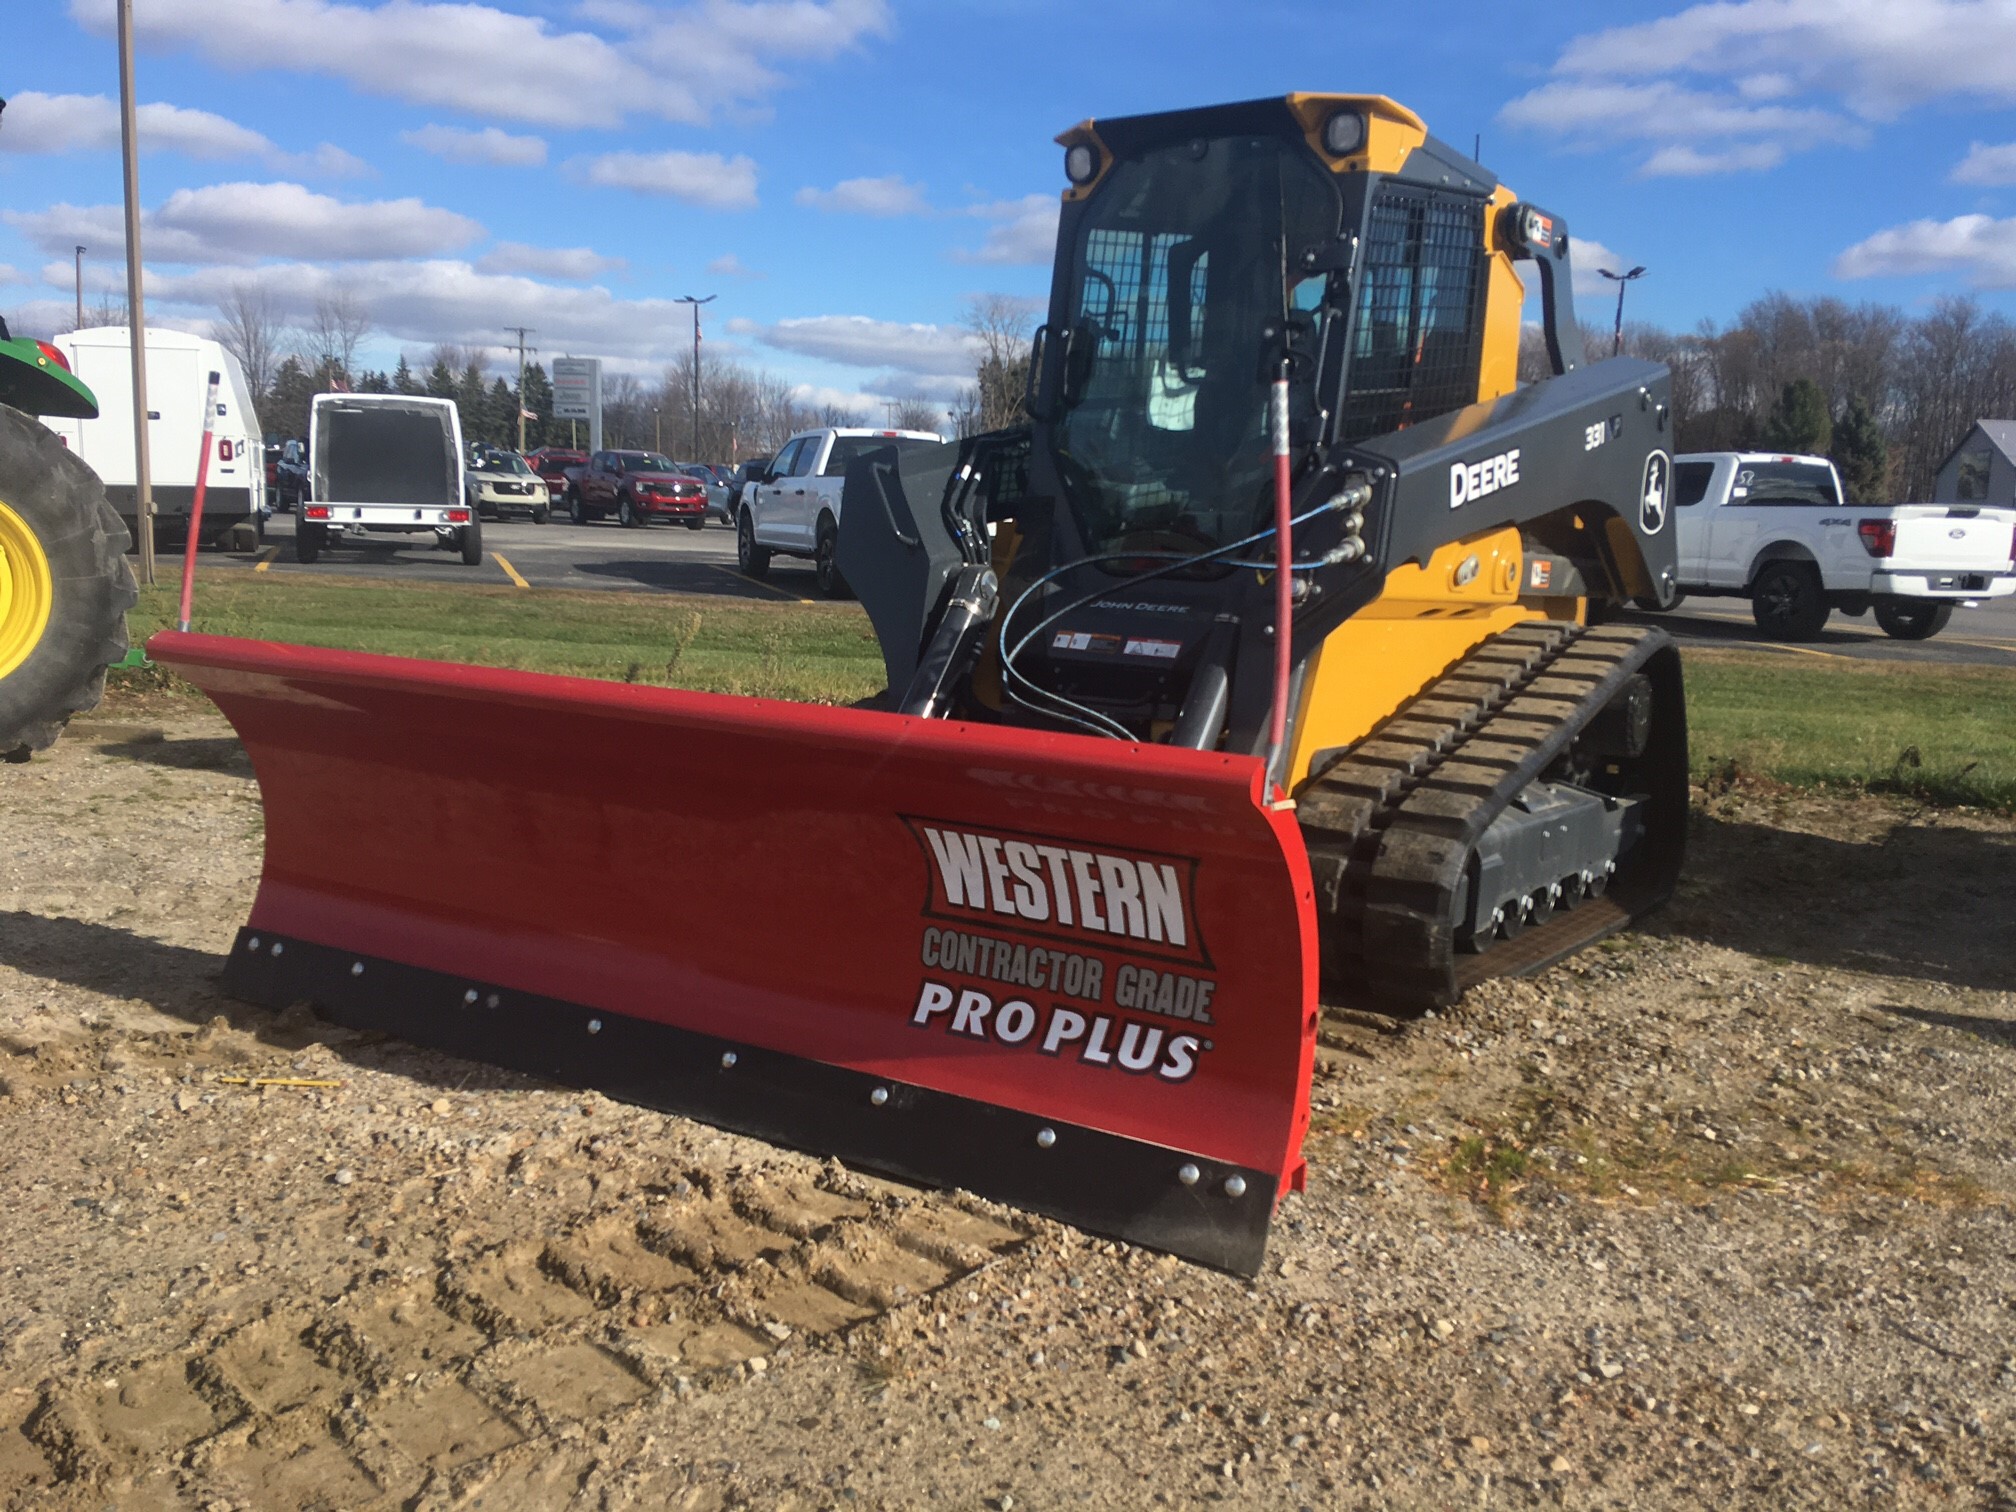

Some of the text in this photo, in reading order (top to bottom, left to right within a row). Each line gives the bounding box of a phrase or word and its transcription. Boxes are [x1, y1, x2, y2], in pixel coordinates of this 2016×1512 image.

[1585, 421, 1605, 451] 331
[1450, 449, 1519, 508] DEERE
[1090, 601, 1191, 614] JOHN DEERE
[924, 827, 1187, 946] WESTERN
[922, 926, 1216, 1024] CONTRACTOR GRADE
[913, 981, 1200, 1079] PRO PLUS
